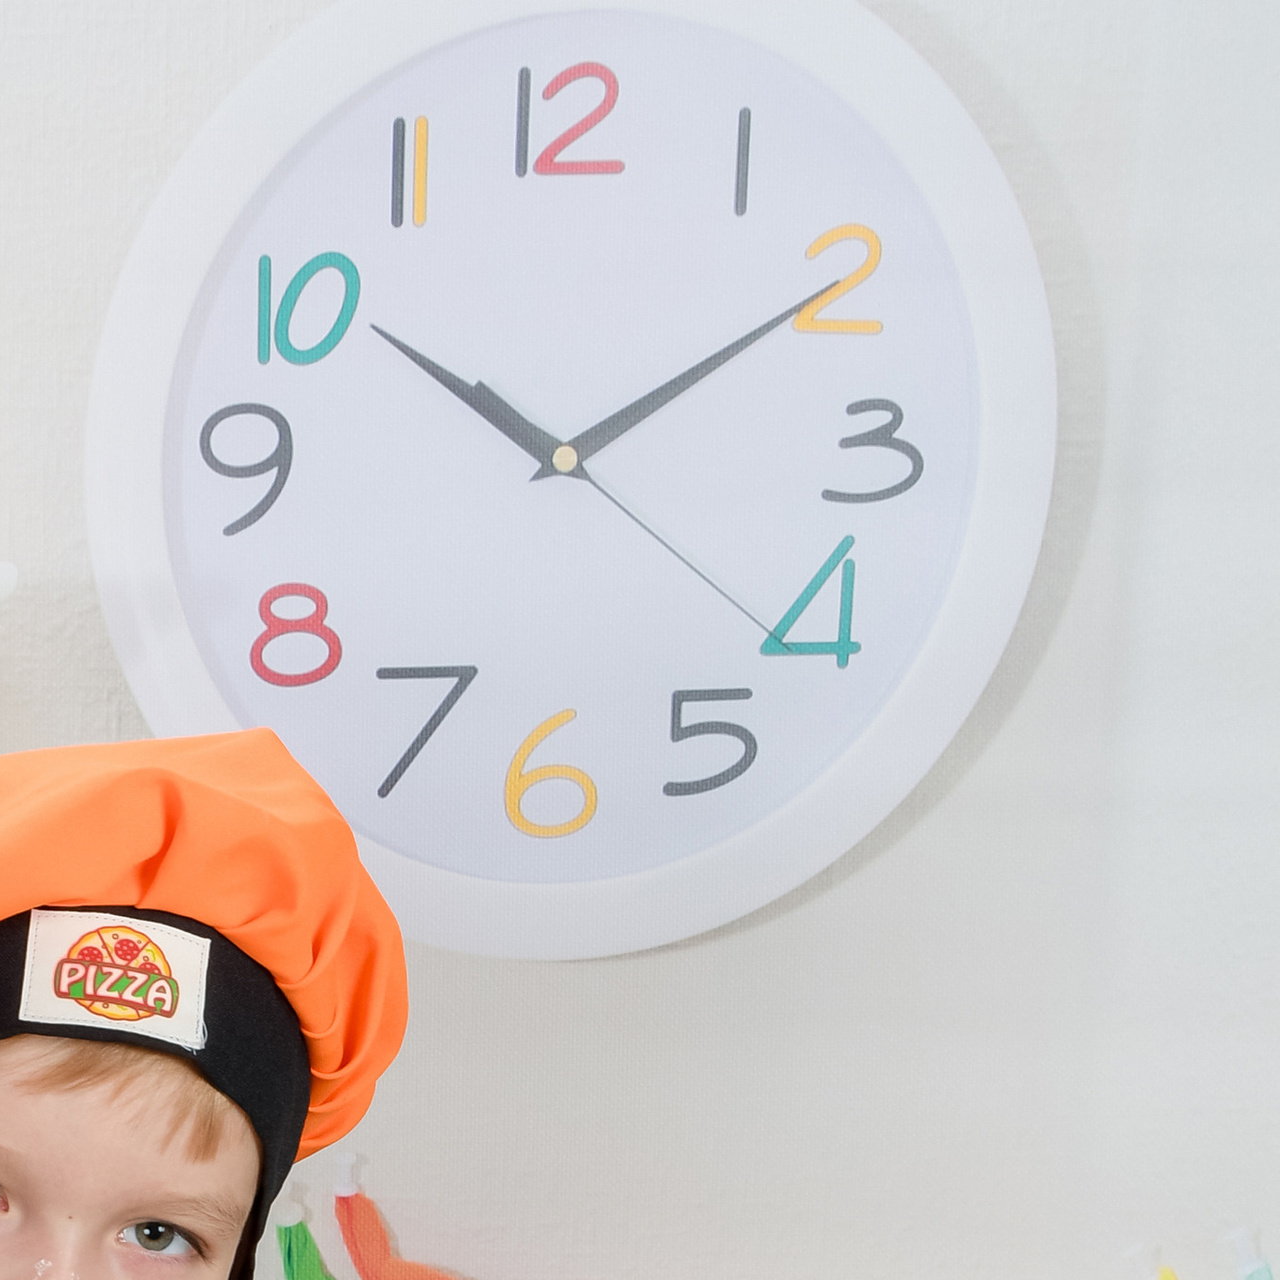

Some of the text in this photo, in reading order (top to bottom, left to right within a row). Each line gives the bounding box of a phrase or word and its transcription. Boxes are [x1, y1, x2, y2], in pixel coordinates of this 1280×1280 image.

[390, 115, 429, 228] 11
[515, 61, 625, 177] 12
[733, 106, 752, 217] 1
[257, 251, 362, 366] 10
[792, 223, 885, 336] 2
[199, 402, 294, 538] 9
[821, 398, 925, 503] 3
[249, 581, 343, 688] 8
[759, 534, 862, 669] 4
[375, 665, 479, 798] 7
[503, 708, 599, 839] 6
[663, 688, 759, 797] 5
[59, 961, 173, 1013] PIZZA
